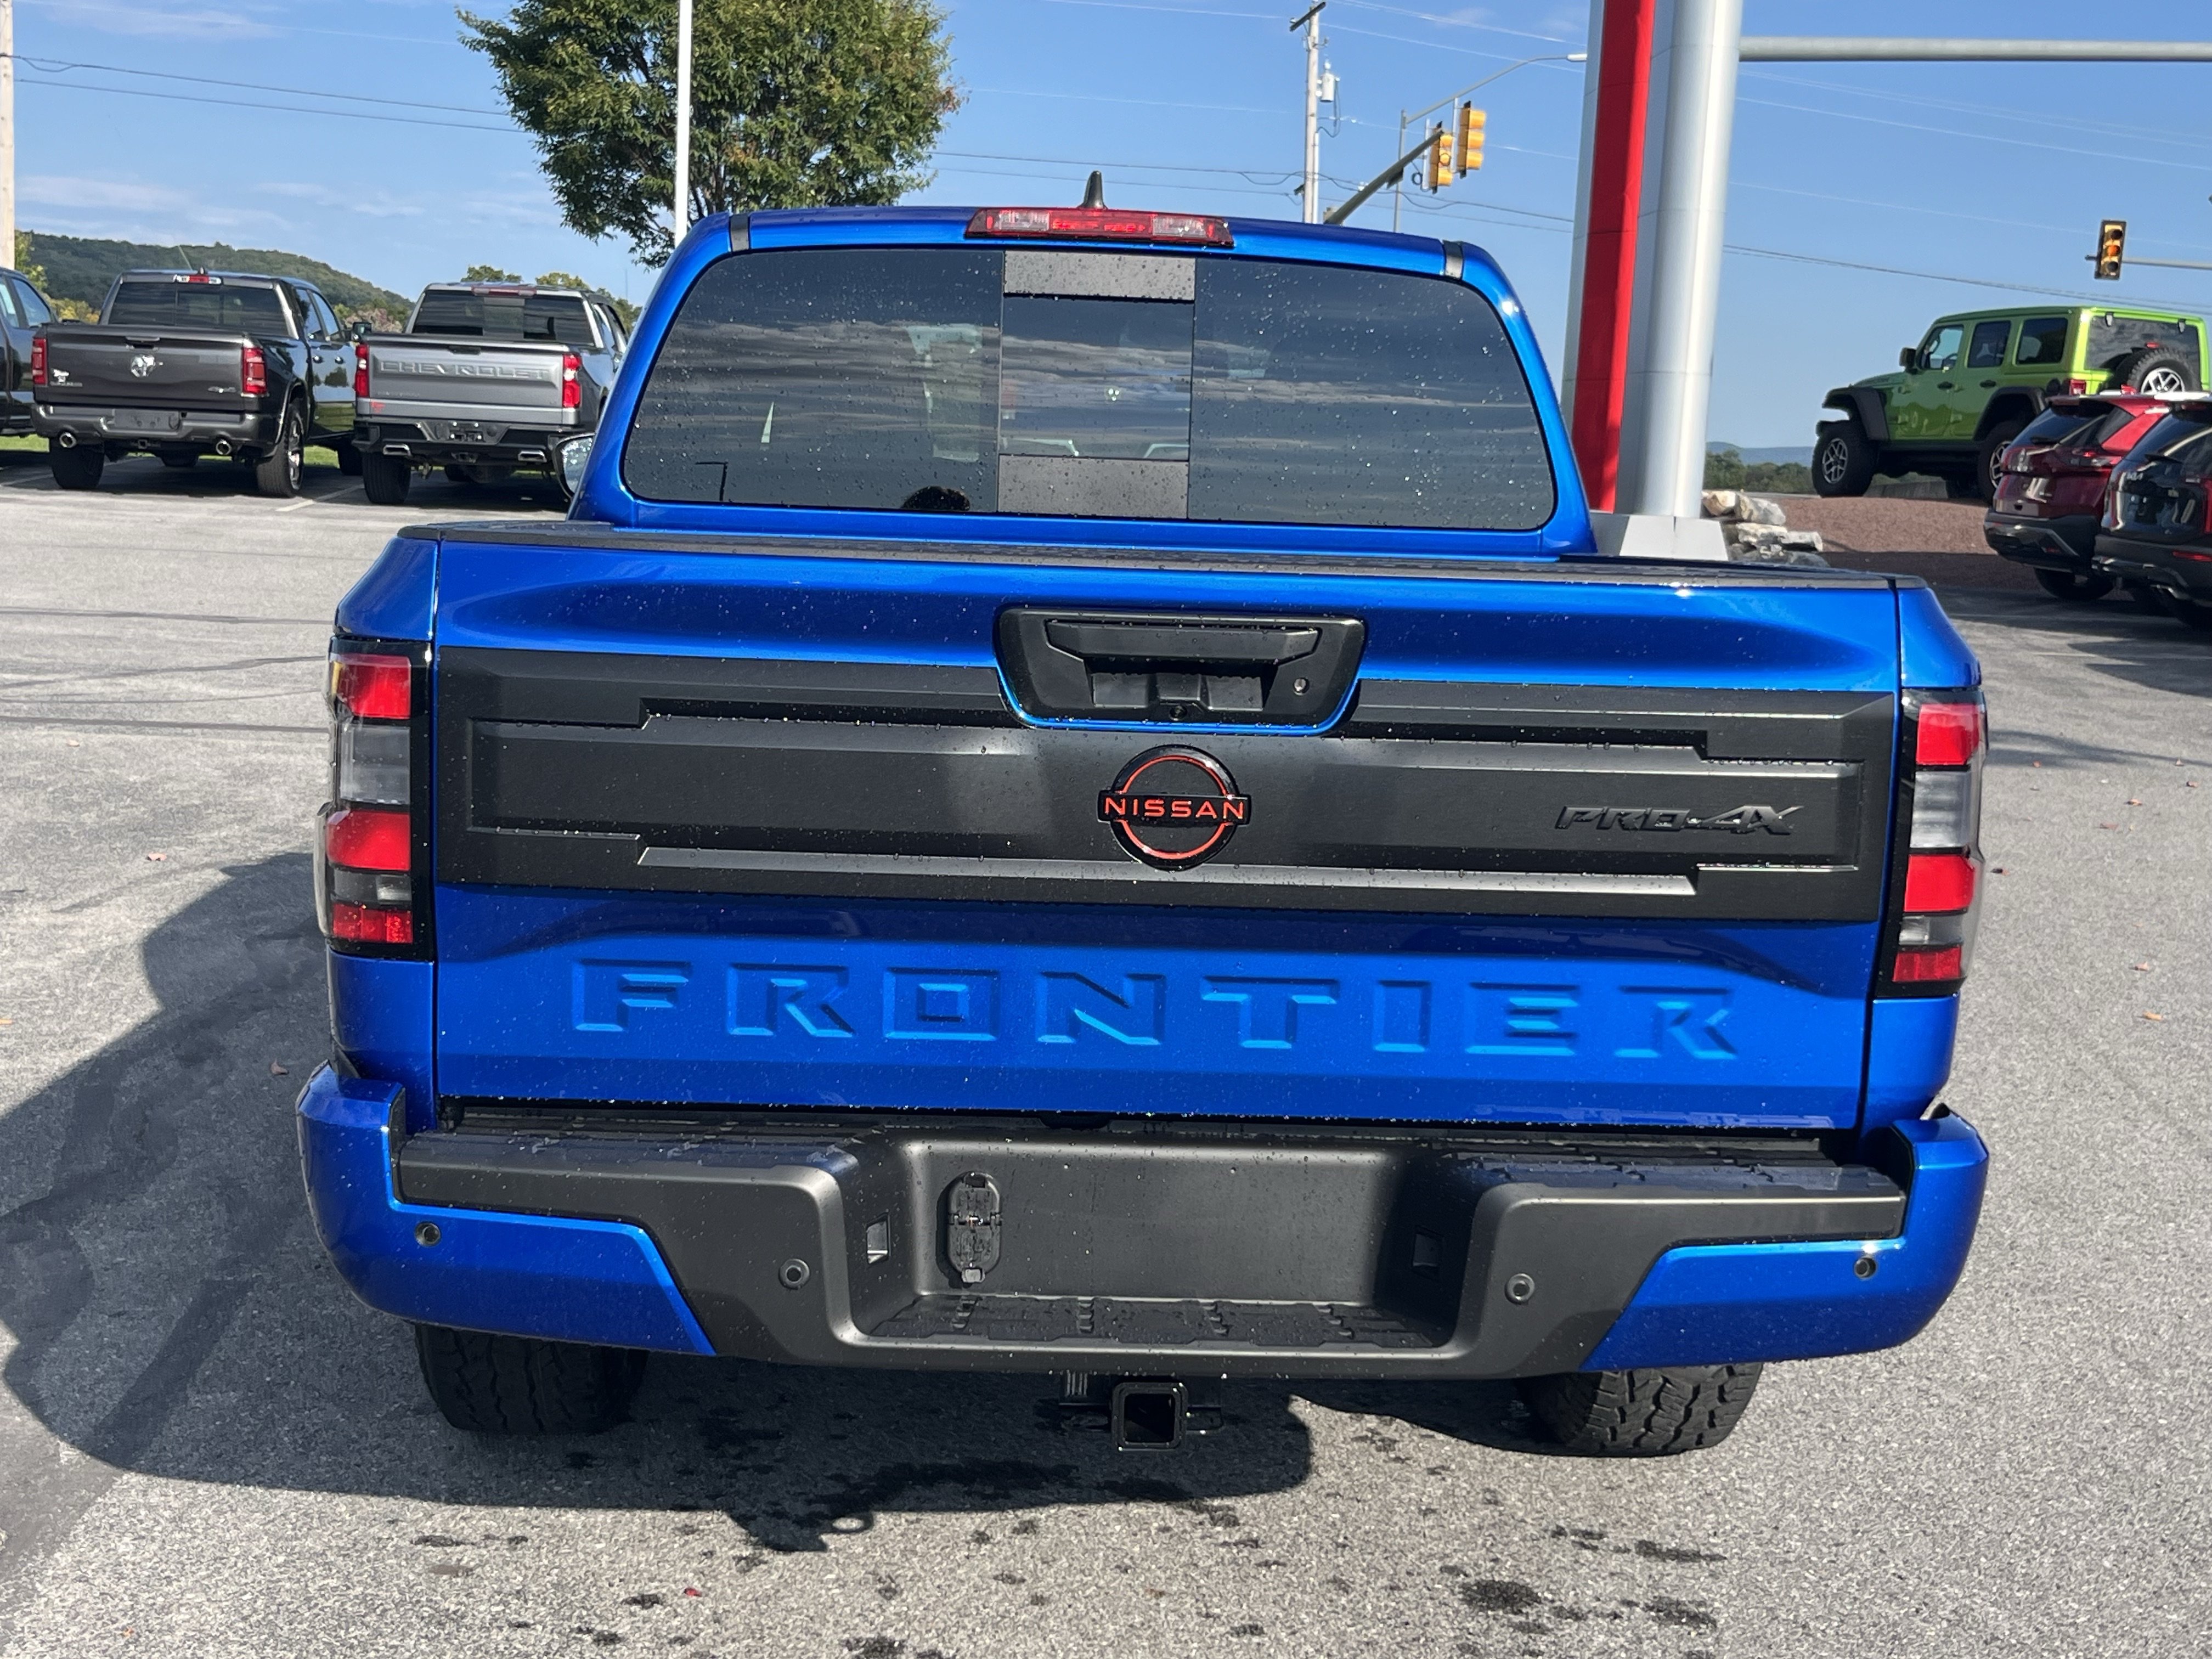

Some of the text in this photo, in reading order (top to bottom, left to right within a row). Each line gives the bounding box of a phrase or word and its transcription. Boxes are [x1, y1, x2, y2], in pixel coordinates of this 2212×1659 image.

[381, 361, 549, 379] CHEVROLET
[1104, 797, 1244, 820] NISSAN
[1555, 805, 1804, 835] PRO-4X
[572, 958, 1738, 1059] FRONTIER
